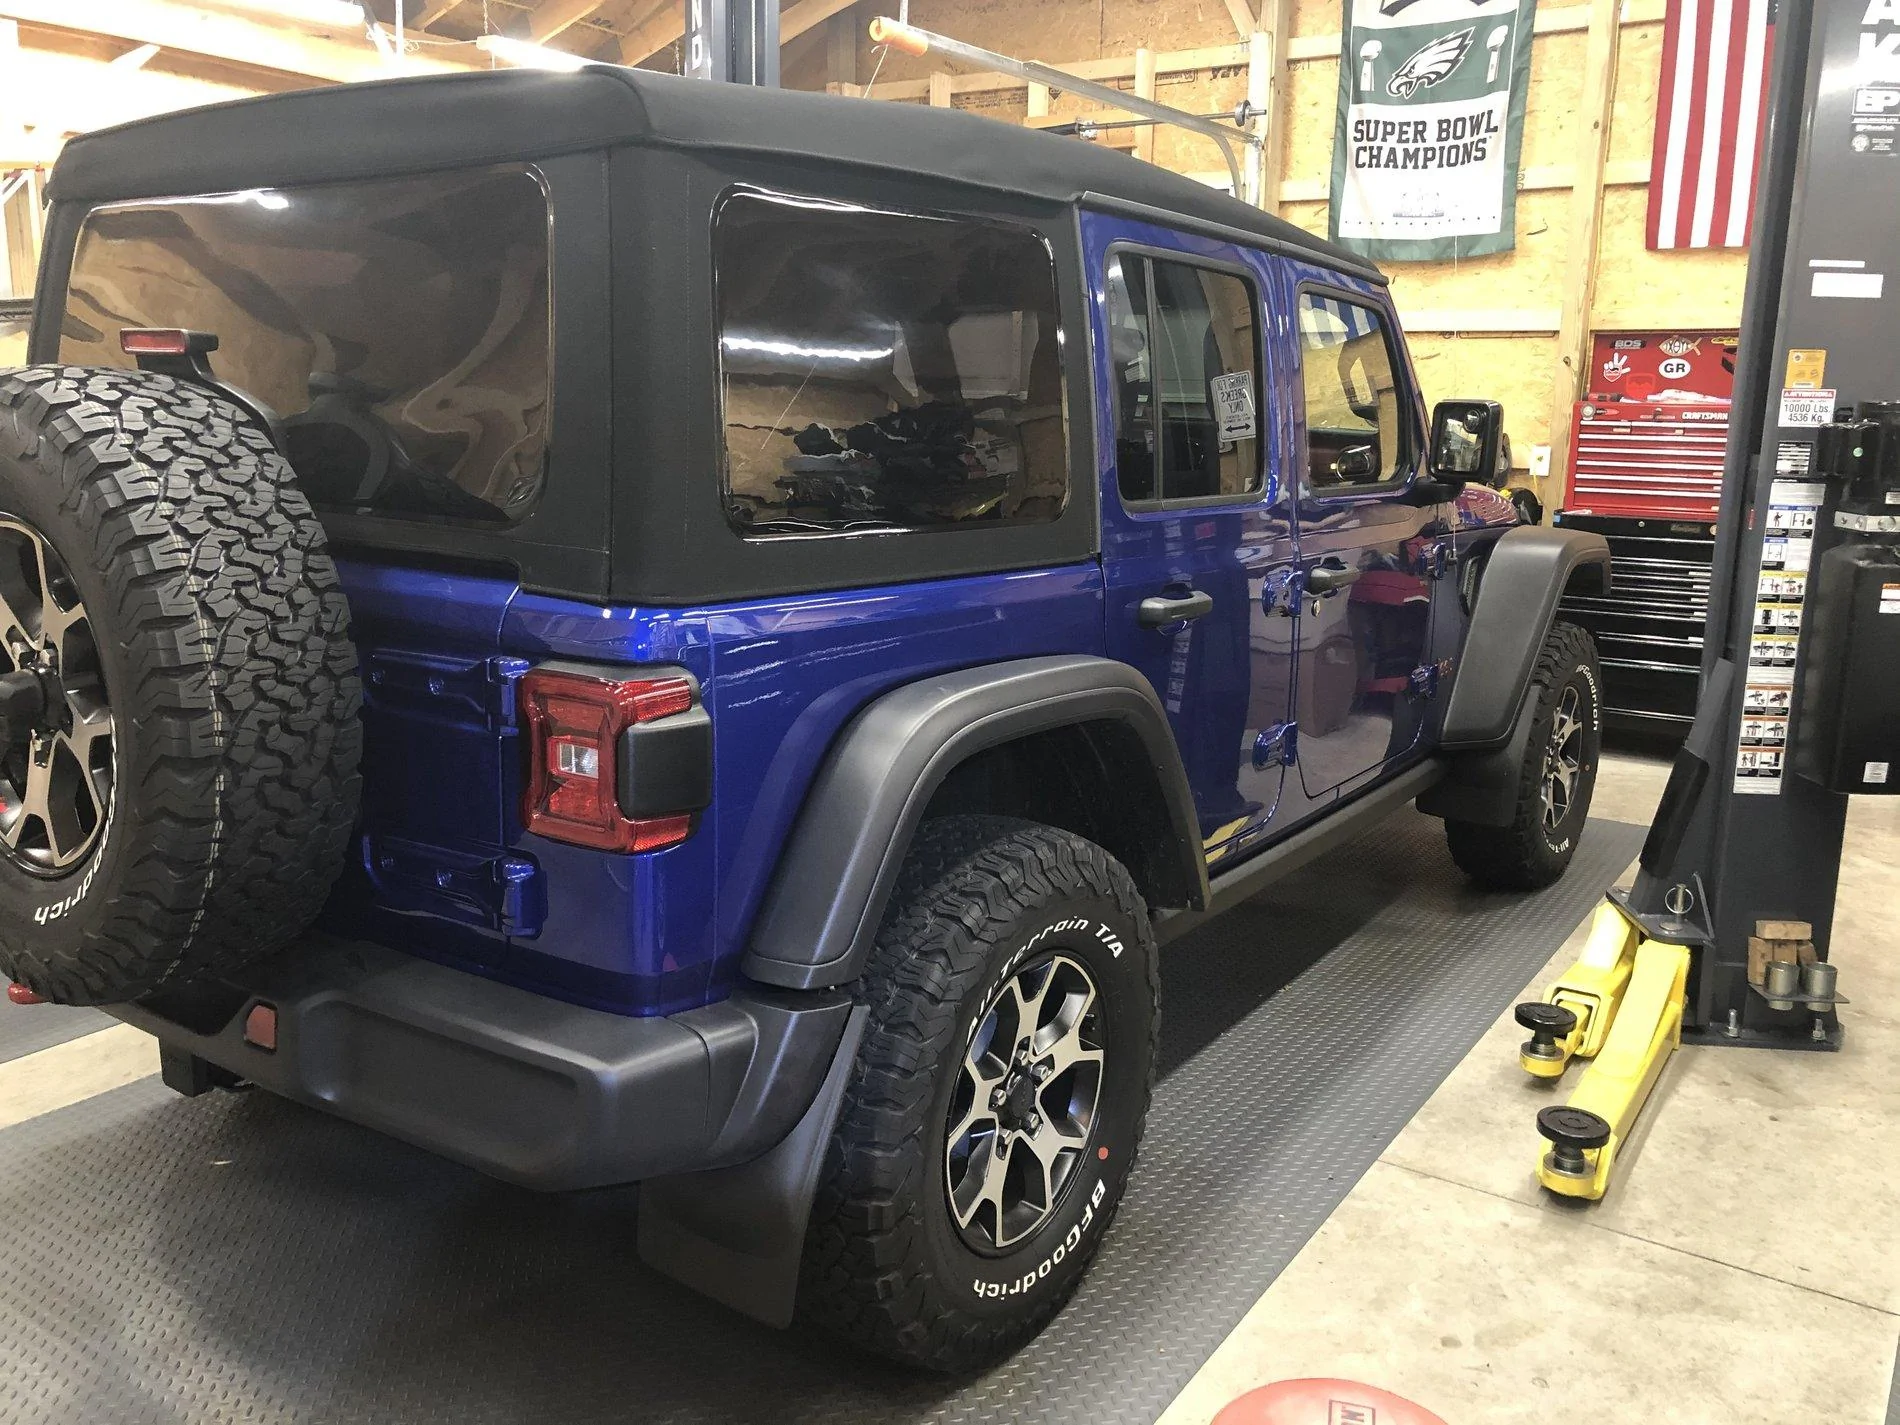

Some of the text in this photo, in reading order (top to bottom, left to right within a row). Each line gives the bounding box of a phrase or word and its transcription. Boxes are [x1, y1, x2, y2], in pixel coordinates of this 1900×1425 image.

[1353, 109, 1499, 144] SUPER BOWL
[1355, 137, 1488, 169] CHAMPIONS
[1663, 363, 1686, 373] GR
[1682, 411, 1729, 421] CRAFTSMAN
[1784, 403, 1811, 413] 10000
[973, 1178, 1106, 1301] BFGoodrich
